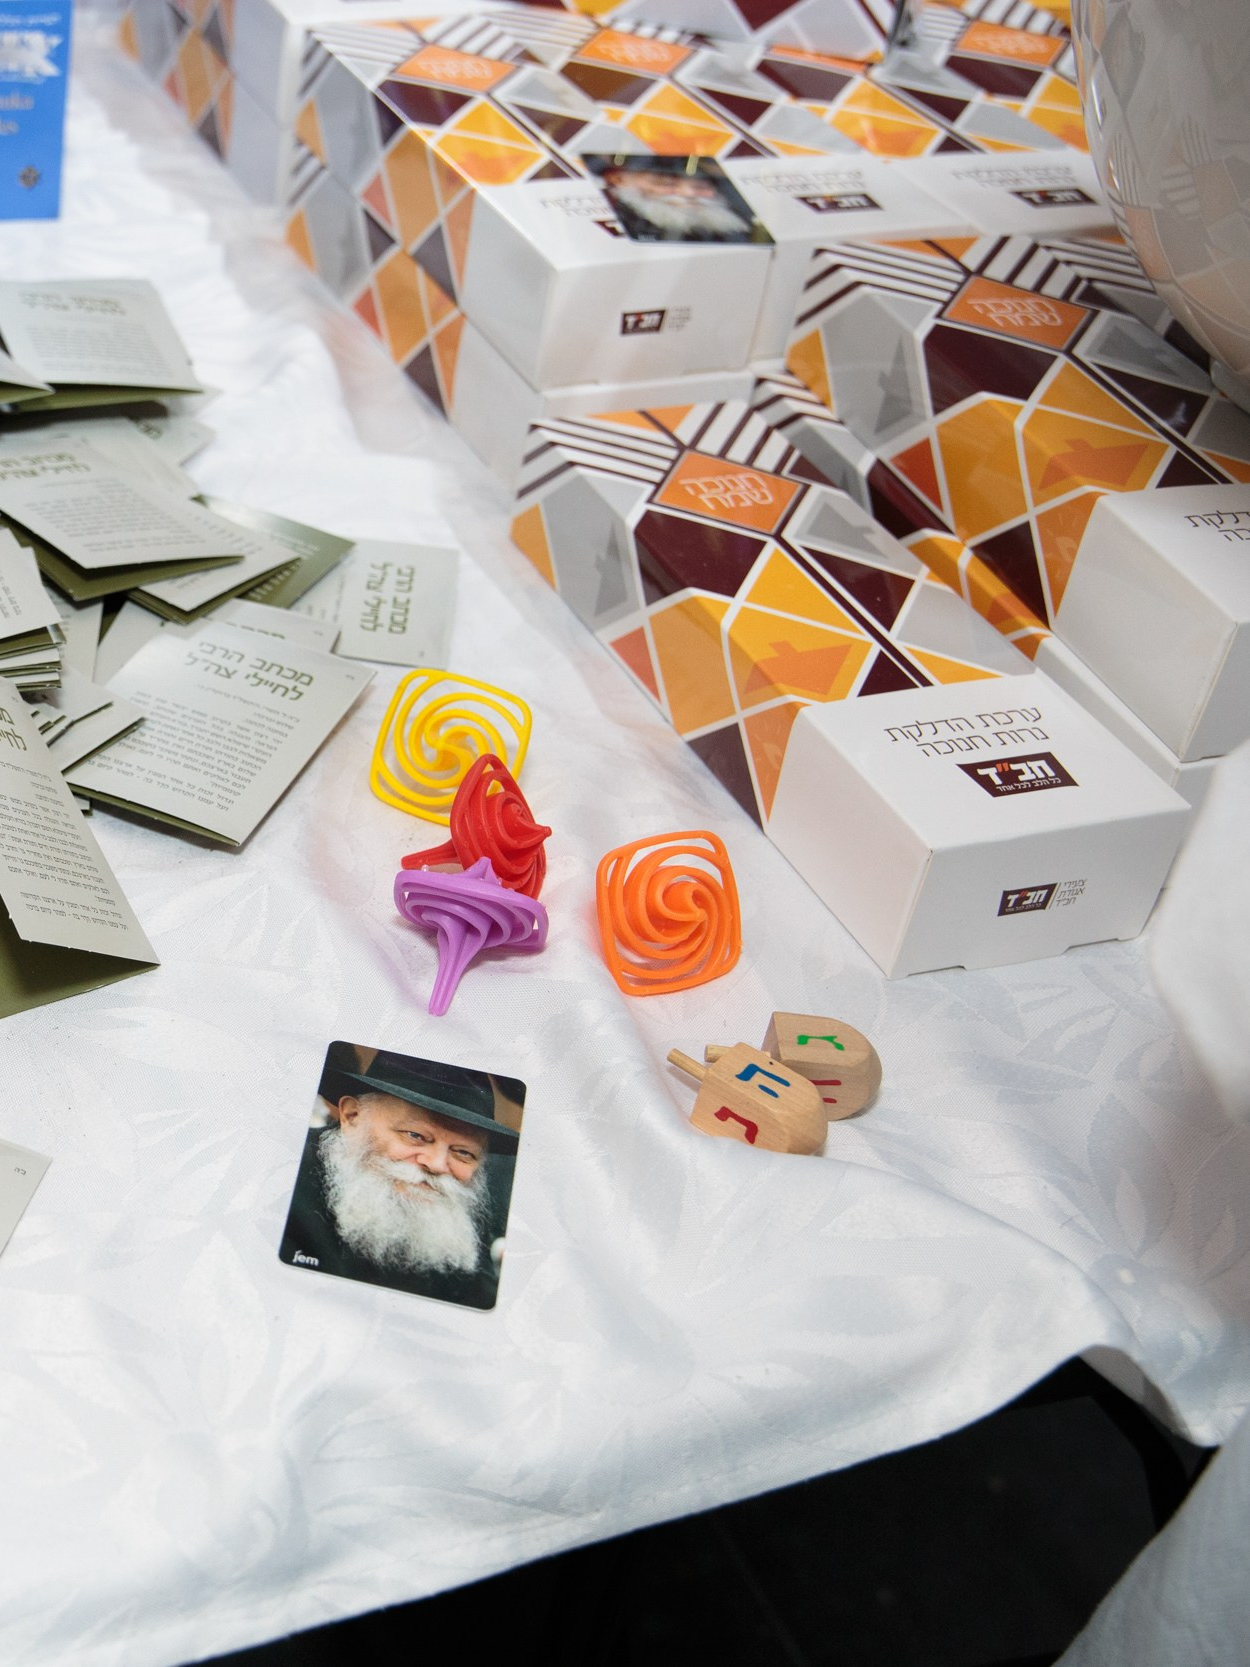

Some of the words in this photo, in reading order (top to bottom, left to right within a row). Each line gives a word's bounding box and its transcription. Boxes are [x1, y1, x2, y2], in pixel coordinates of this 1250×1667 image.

[1184, 509, 1250, 529] דלקת
[366, 562, 392, 592] צה"ל
[396, 566, 415, 593] הרבי
[360, 596, 386, 632] לחיילי
[388, 596, 411, 634] מכתב
[199, 642, 246, 664] הרבי
[188, 653, 241, 680] צה"ל
[250, 658, 314, 687] מכתב
[245, 672, 304, 701] לחיילי
[884, 717, 975, 743] הדלקת
[975, 707, 1042, 728] ערכת
[916, 735, 992, 757] חנוכה
[992, 727, 1050, 746] נרות
[977, 760, 1056, 785] חב"ד
[1032, 779, 1050, 787] הלב
[996, 784, 1015, 792] אחד
[1007, 889, 1048, 908] חב"ד
[734, 1063, 791, 1098] ה
[291, 1250, 319, 1267] jem
